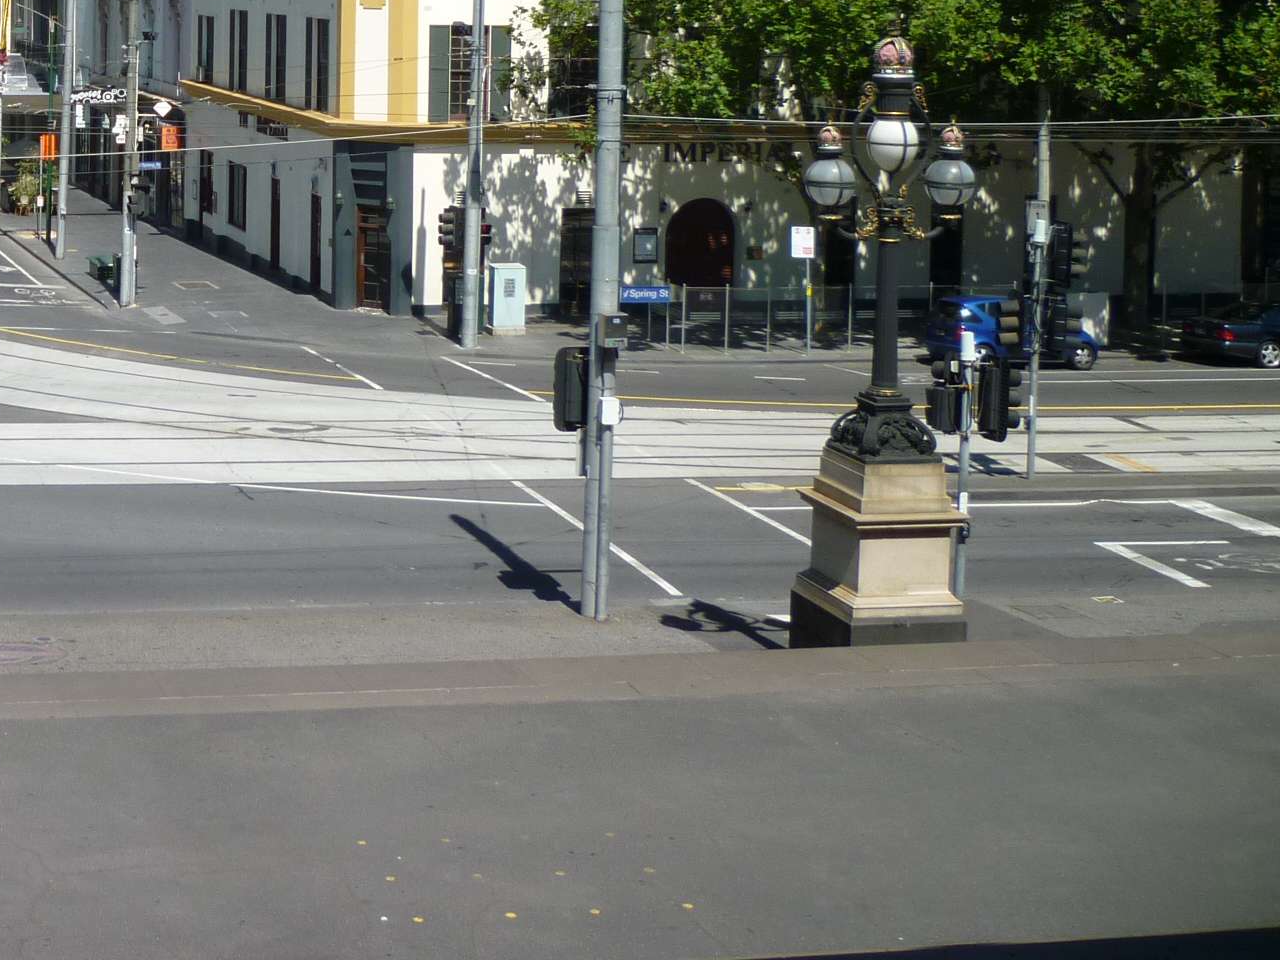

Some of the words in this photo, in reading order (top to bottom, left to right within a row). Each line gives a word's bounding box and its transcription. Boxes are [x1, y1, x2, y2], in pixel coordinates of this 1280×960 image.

[663, 141, 800, 163] IMPERIAL
[629, 288, 657, 299] Spring
[659, 288, 670, 298] St
